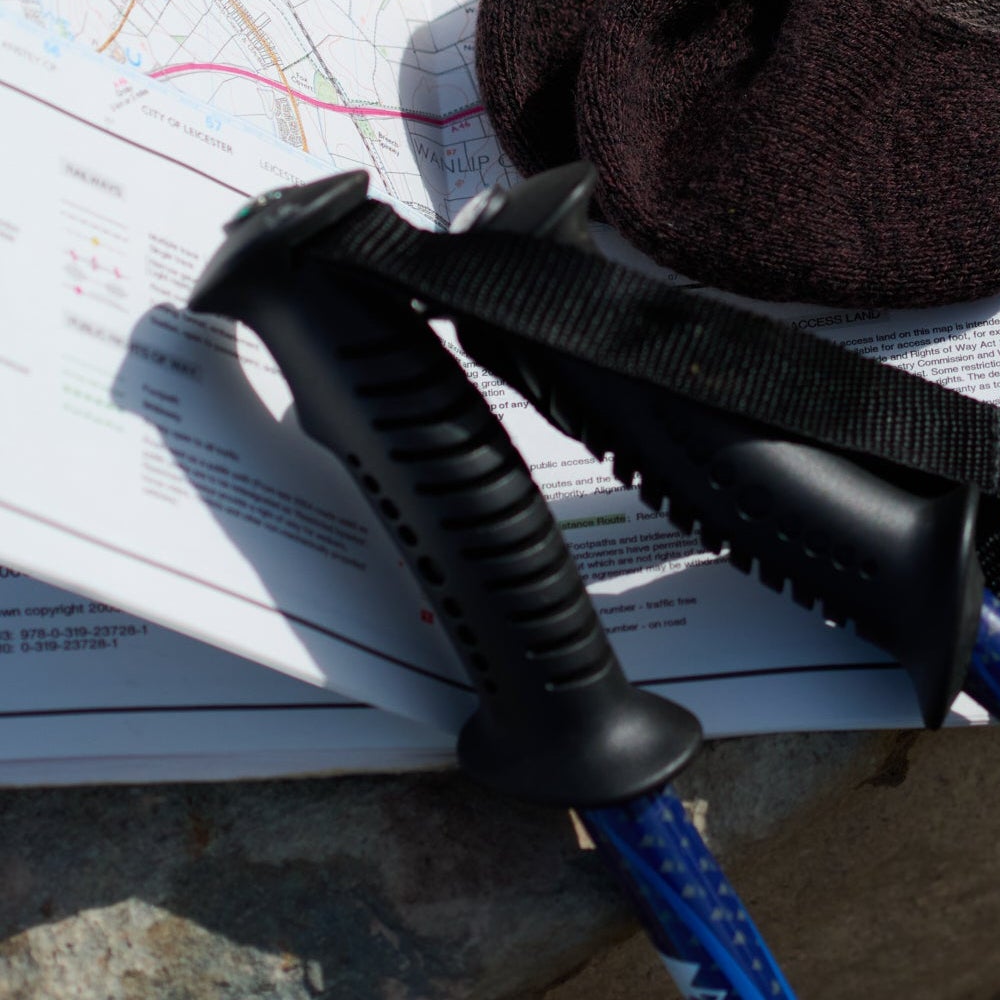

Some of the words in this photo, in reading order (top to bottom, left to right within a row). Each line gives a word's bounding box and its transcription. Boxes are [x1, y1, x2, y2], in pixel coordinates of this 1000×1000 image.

[141, 104, 164, 122] CITY
[167, 116, 180, 128] OF
[183, 123, 234, 154] LEICESTER
[414, 138, 490, 173] WANLIP
[792, 314, 843, 329] ACCESS
[846, 309, 881, 323] LAND
[876, 331, 896, 342] land
[899, 330, 911, 338] on
[914, 326, 930, 337] this
[932, 325, 954, 337] map
[881, 343, 894, 351] for
[897, 339, 931, 349] access
[948, 333, 971, 342] foot,
[974, 329, 986, 338] for
[890, 352, 908, 360] and
[910, 348, 940, 359] Rights
[943, 345, 952, 353] of
[955, 341, 977, 351] Way
[917, 354, 975, 367] Commission
[977, 351, 995, 359] and
[931, 365, 959, 375] Some
[936, 374, 965, 387] rights.
[968, 372, 986, 381] The
[979, 382, 991, 390] as
[511, 400, 529, 412] any
[530, 460, 558, 472] public
[561, 458, 595, 468] access
[541, 480, 573, 490] routes
[575, 477, 594, 487] and
[596, 475, 611, 483] the
[544, 489, 589, 501] authority.
[561, 520, 594, 530] stance
[569, 538, 616, 551] Footpaths
[619, 535, 638, 544] and
[626, 545, 650, 555] have
[653, 539, 698, 552] permitted
[588, 559, 615, 570] which
[618, 557, 634, 565] are
[637, 555, 652, 564] not
[655, 551, 681, 563] rights
[683, 549, 694, 558] of
[592, 565, 643, 579] agreement
[646, 564, 666, 575] may
[669, 561, 682, 570] be
[24, 603, 84, 618] copyright
[600, 604, 636, 615] number
[646, 599, 674, 610] traffic
[678, 596, 697, 606] free
[649, 621, 662, 630] on
[664, 617, 687, 627] road
[20, 624, 148, 640] 978-0-319-23728-1
[20, 638, 119, 653] 0-319-23728-1
